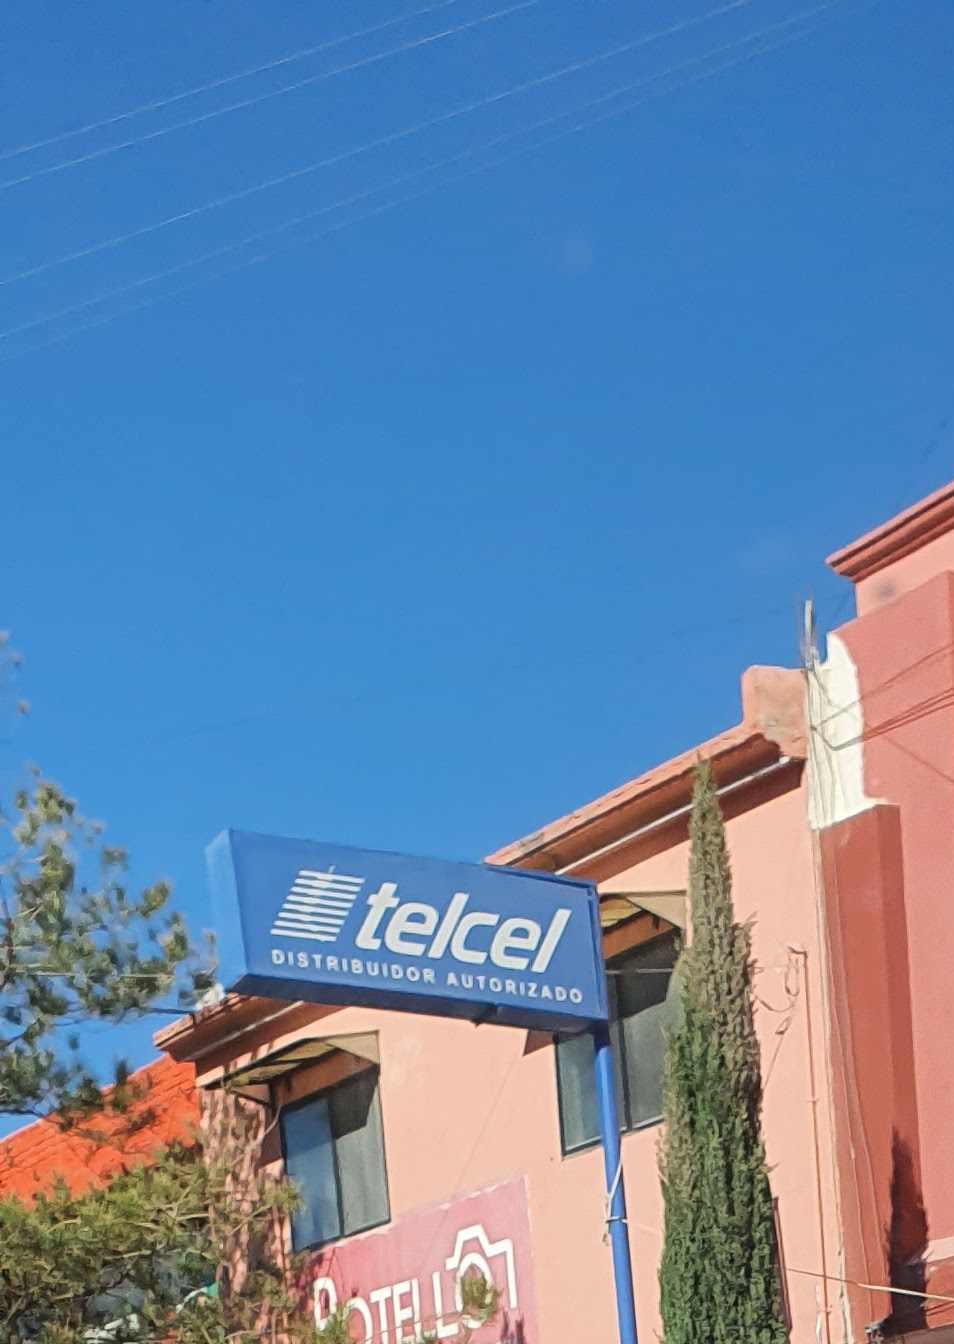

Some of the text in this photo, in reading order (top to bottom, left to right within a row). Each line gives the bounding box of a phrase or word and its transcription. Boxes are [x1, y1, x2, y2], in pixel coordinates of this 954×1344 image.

[355, 882, 572, 974] telcel
[271, 949, 583, 1005] DISTRIBUIDOR AUTORIZADO
